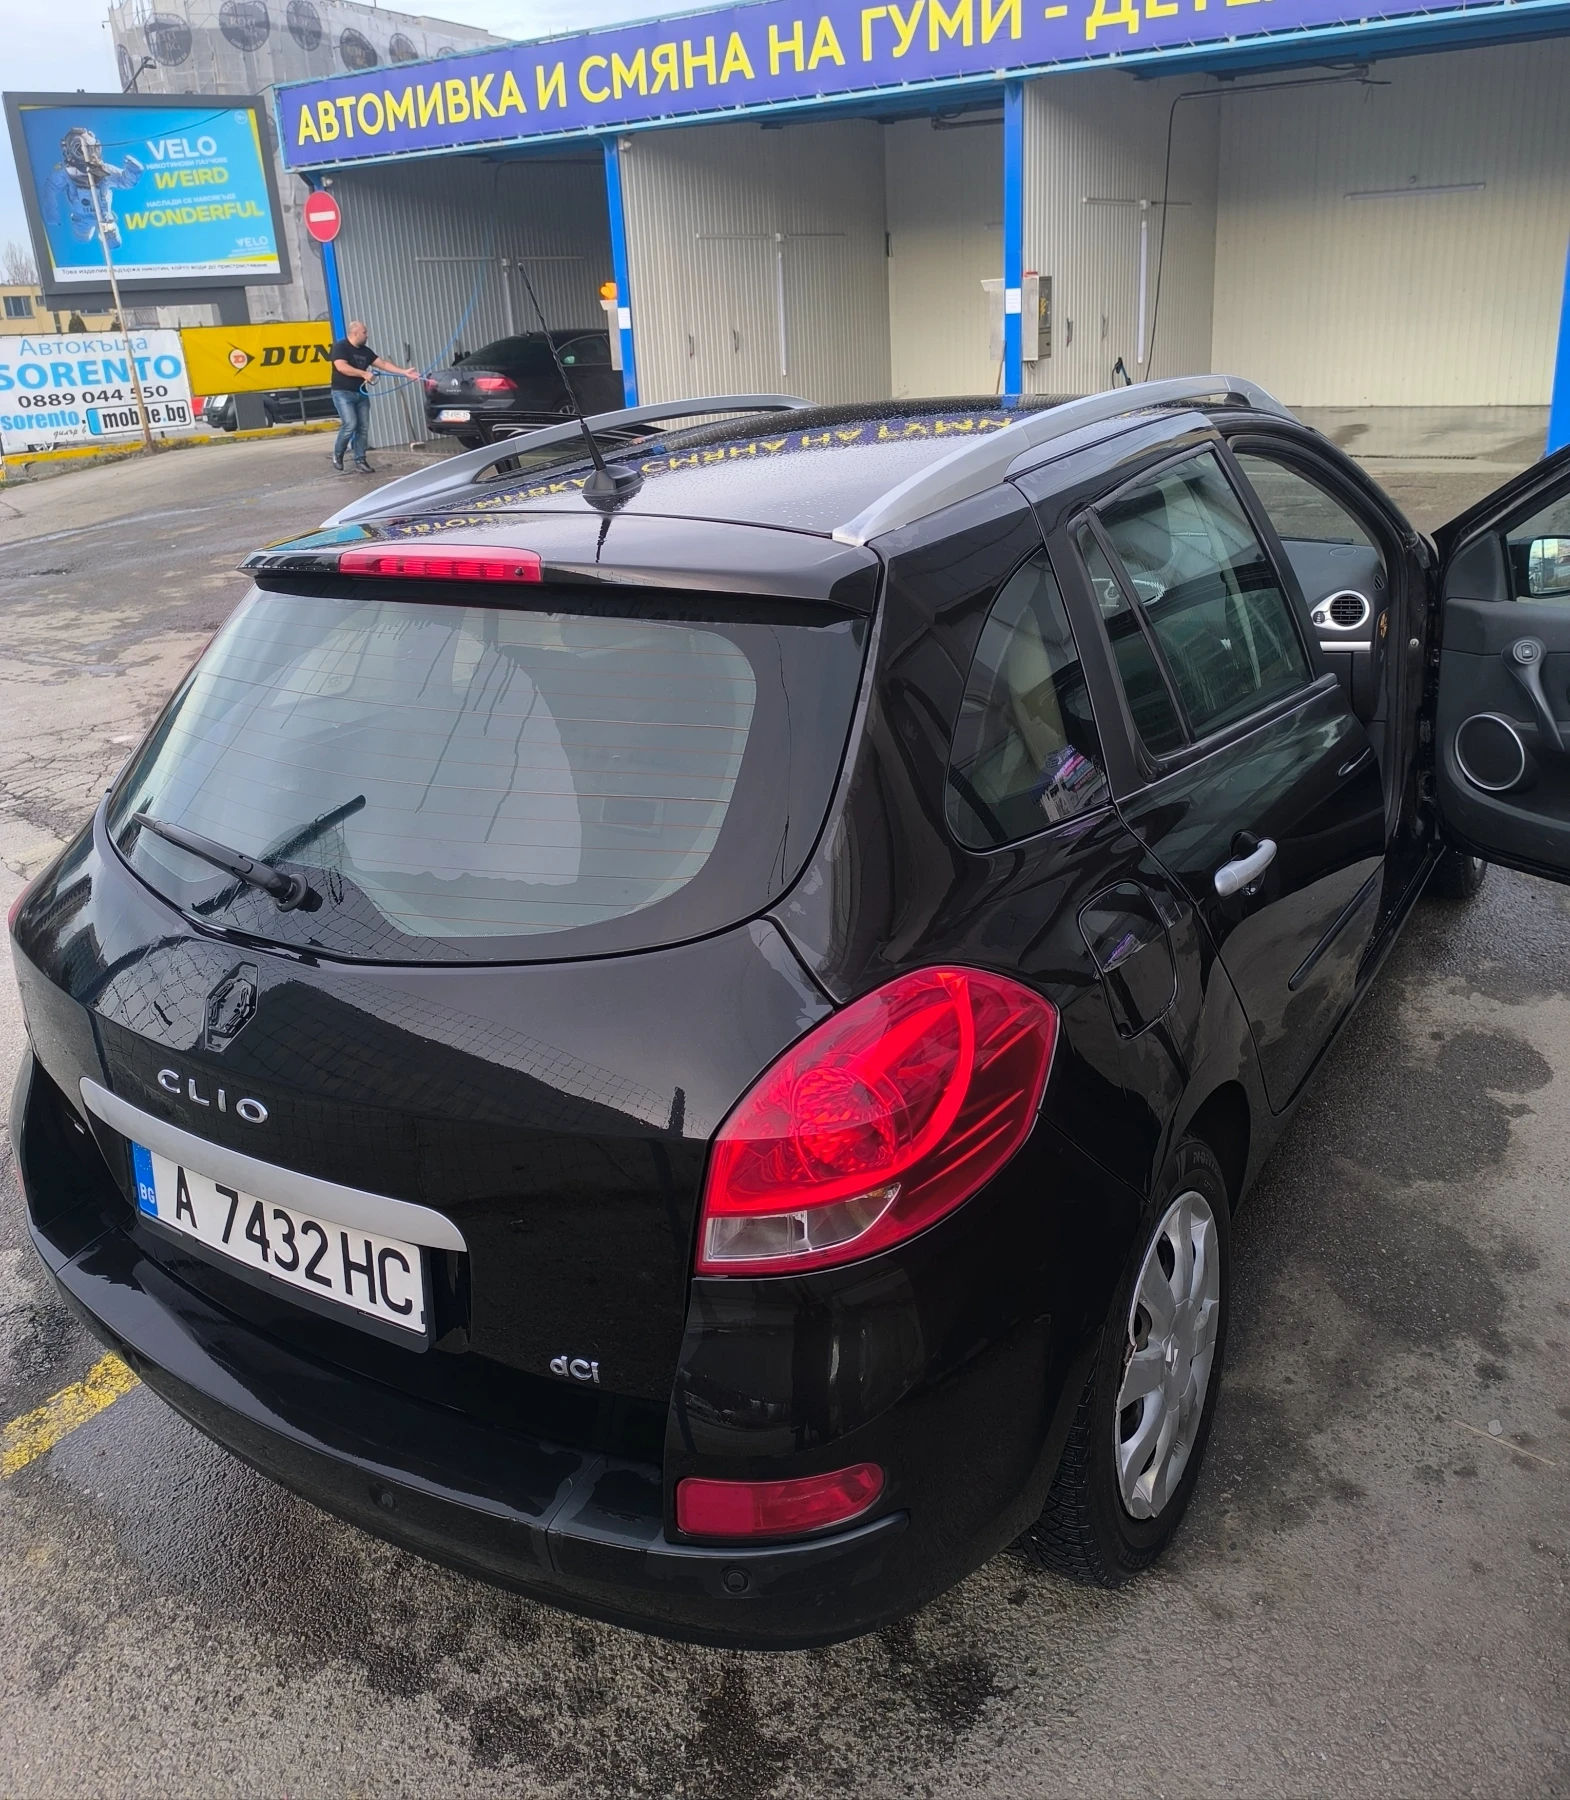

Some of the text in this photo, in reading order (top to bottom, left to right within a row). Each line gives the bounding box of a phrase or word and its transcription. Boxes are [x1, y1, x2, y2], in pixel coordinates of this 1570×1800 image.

[297, 70, 527, 146] АВТОМИВКА
[536, 62, 567, 112] И
[578, 31, 755, 104] СМЯНА
[768, 16, 847, 76] НА
[861, 0, 1022, 62] ГУМИ
[147, 136, 217, 160] VELO
[154, 166, 229, 190] WEIRD
[125, 200, 265, 230] WONDERFUL
[235, 235, 269, 248] VELO
[110, 266, 140, 274] ъдържа
[20, 337, 148, 357] Автокъща
[260, 344, 333, 367] DUN
[0, 355, 182, 391] SORENTO
[18, 392, 75, 408] 0889
[82, 389, 124, 404] 044
[102, 404, 187, 429] moble.bg
[157, 1068, 268, 1124] CLIO
[139, 1182, 155, 1204] BG
[175, 1165, 198, 1230] A
[550, 1355, 600, 1383] dCi
